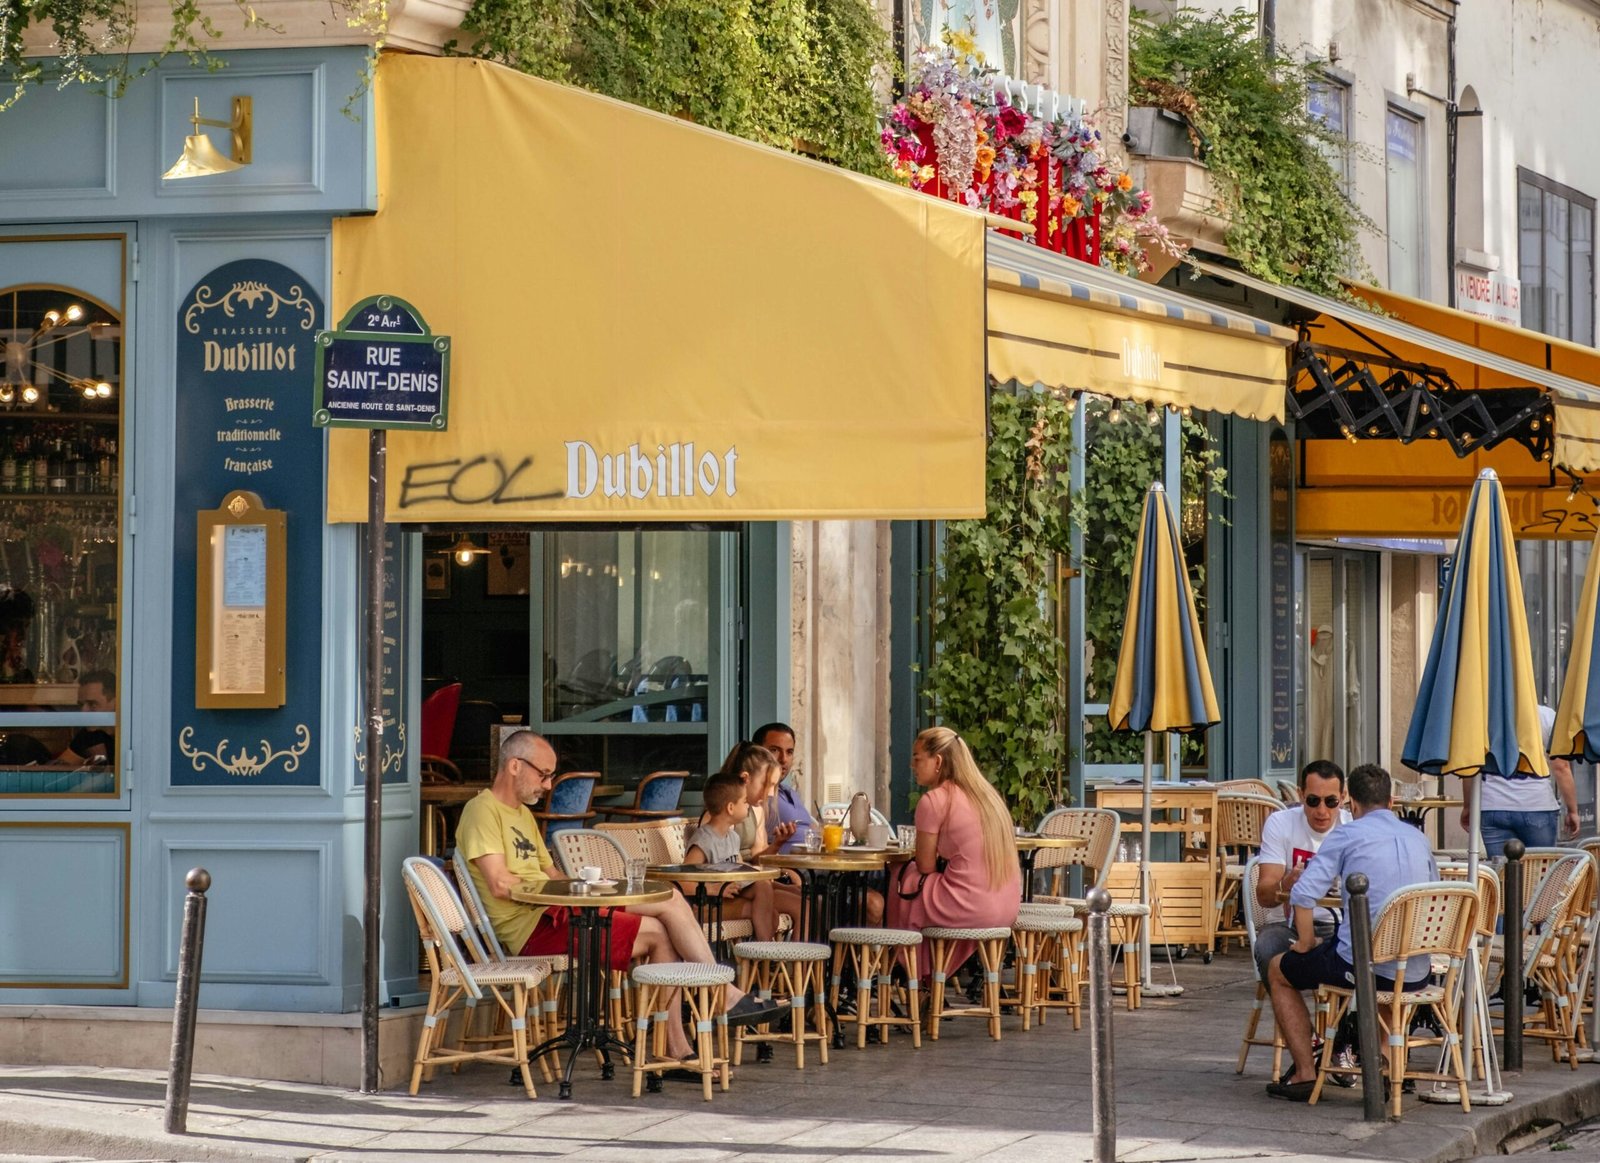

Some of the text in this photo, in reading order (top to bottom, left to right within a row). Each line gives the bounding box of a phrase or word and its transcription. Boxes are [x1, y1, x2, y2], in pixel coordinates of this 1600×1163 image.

[213, 327, 287, 336] BRASSERIE
[203, 341, 297, 372] Dubillot
[366, 346, 401, 366] RUE
[327, 369, 439, 393] SAINT-DENIS
[224, 397, 275, 412] Brasserie
[327, 401, 436, 413] ANCIENNE ROUTE DE SAINT-DENIS
[216, 428, 281, 442] traditionnelle
[224, 457, 273, 476] française
[564, 440, 738, 499] Dubillot
